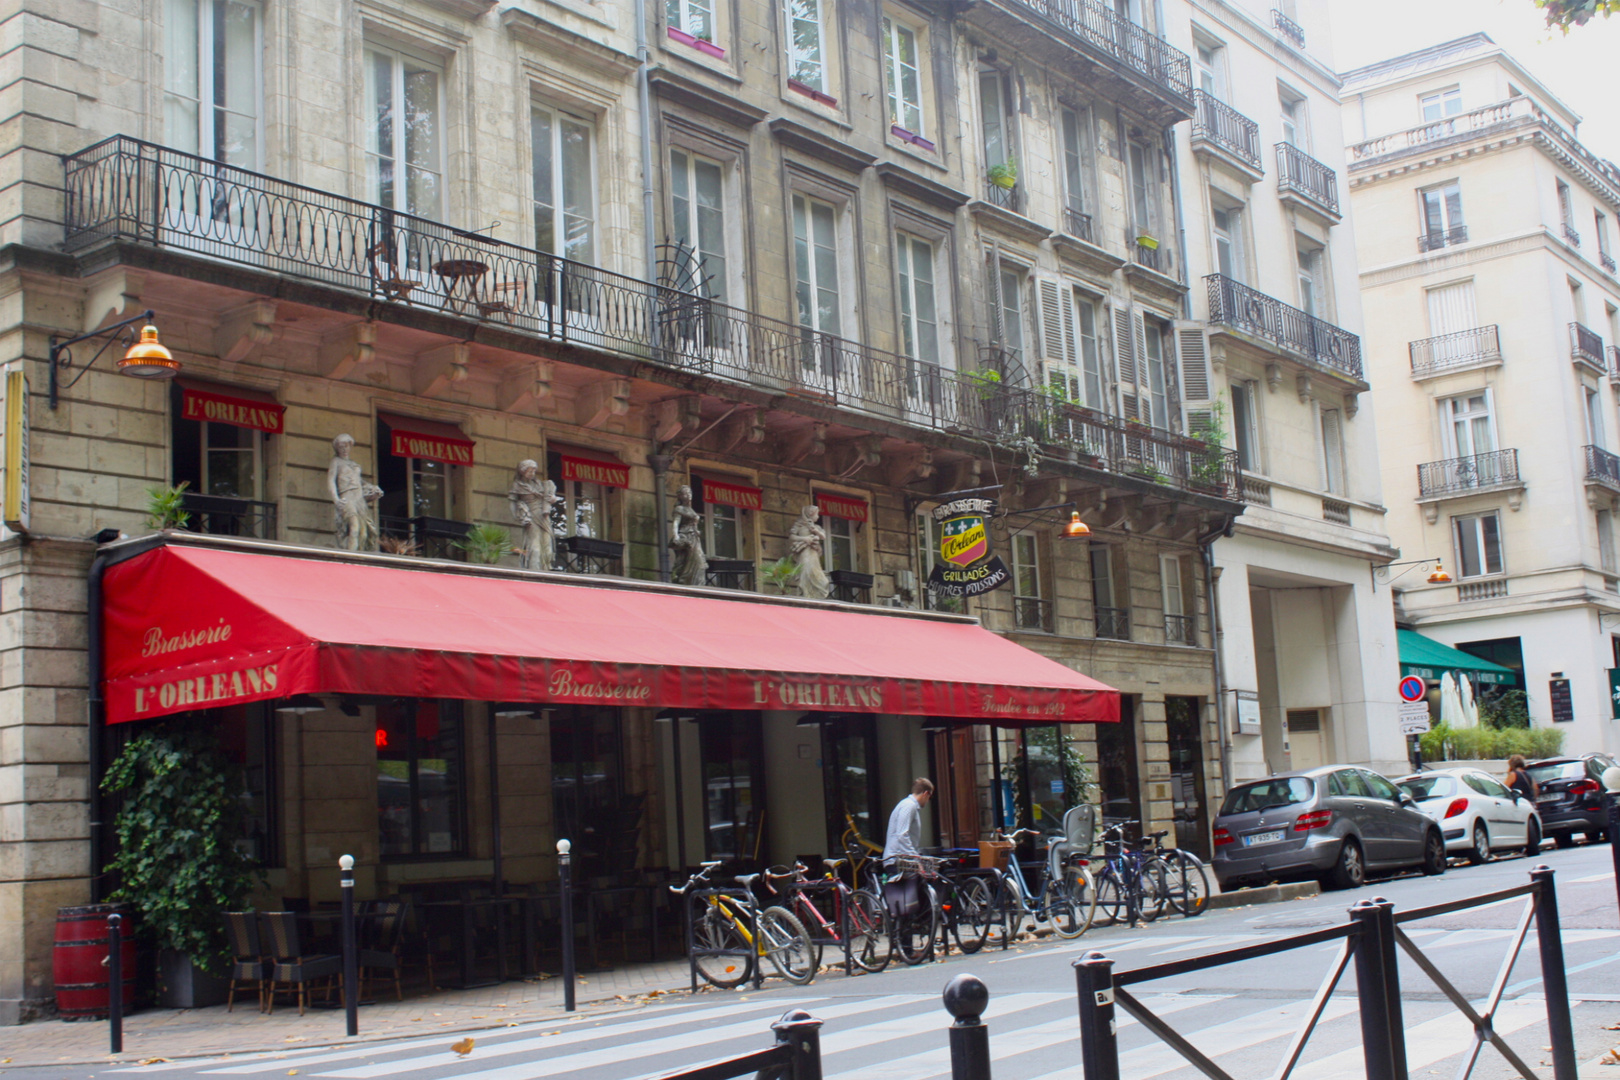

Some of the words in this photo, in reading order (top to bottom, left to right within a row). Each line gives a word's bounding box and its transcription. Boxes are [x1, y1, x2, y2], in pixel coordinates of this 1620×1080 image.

[186, 396, 279, 430] L'ORLEANS
[394, 435, 470, 463] L'ORLEANS
[564, 461, 626, 485] L'ORLEANS
[704, 485, 759, 508] L'ORLEANS
[965, 569, 1006, 595] POISSONS
[141, 617, 233, 658] Brasserie
[135, 664, 279, 713] L'ORLEANS
[548, 669, 651, 700] Brasserie
[753, 680, 883, 708] L'ORLEANS
[982, 694, 1022, 714] Fondée
[1026, 705, 1040, 715] en
[1044, 702, 1066, 716] 1942
